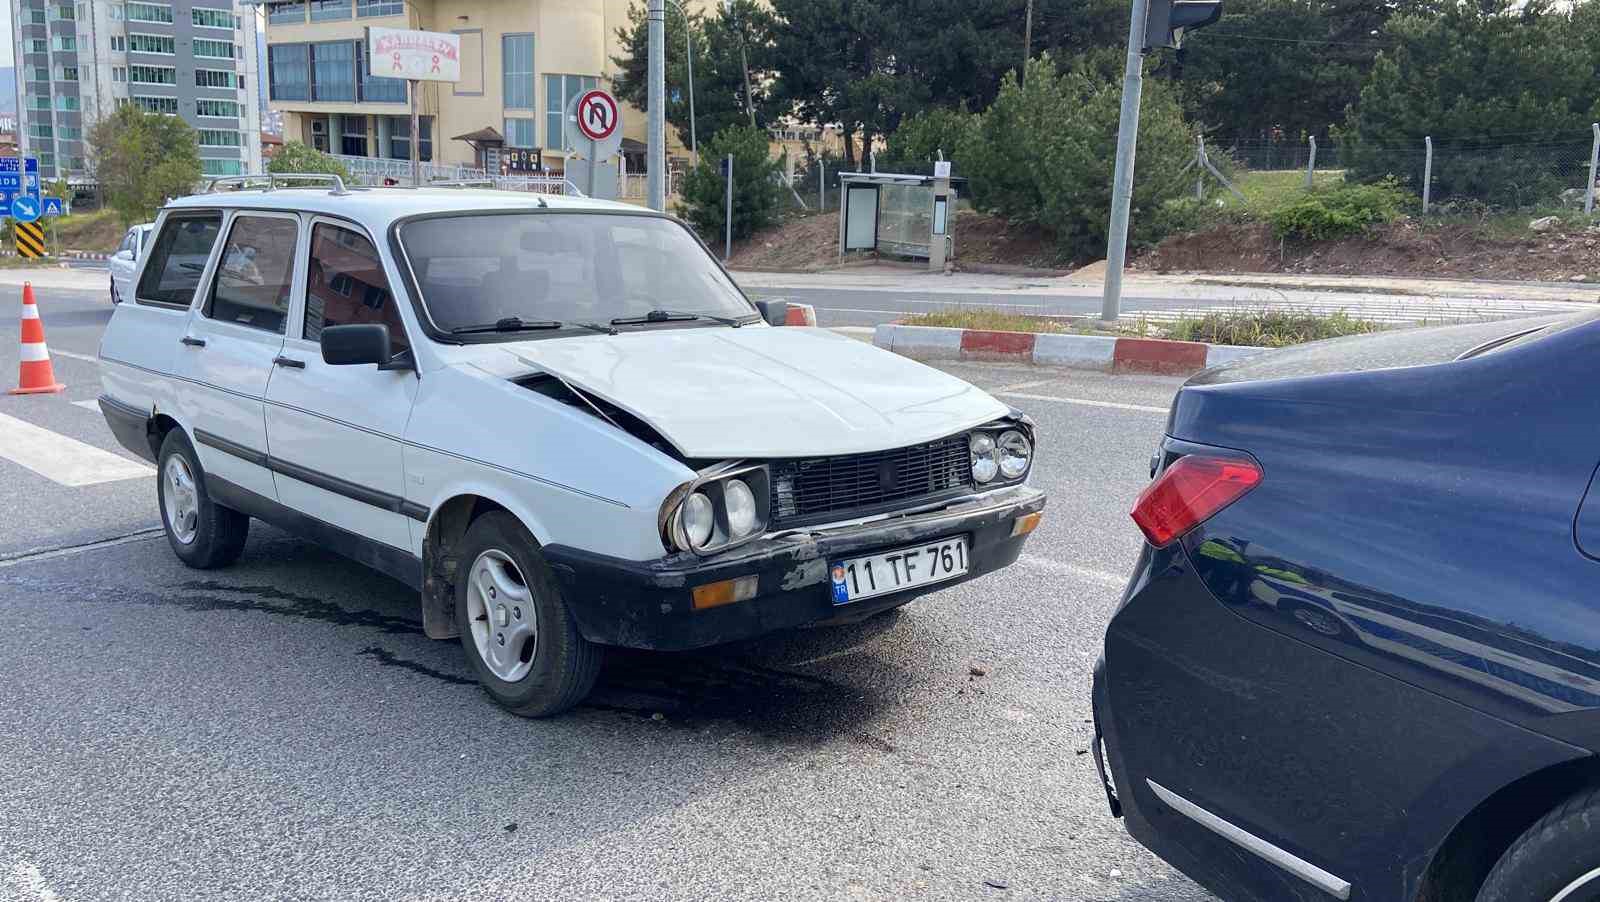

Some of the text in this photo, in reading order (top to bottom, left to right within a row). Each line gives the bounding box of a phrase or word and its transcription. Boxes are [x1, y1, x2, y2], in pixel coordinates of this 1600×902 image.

[848, 541, 964, 594] 11 TF 761
[836, 583, 847, 594] TR
